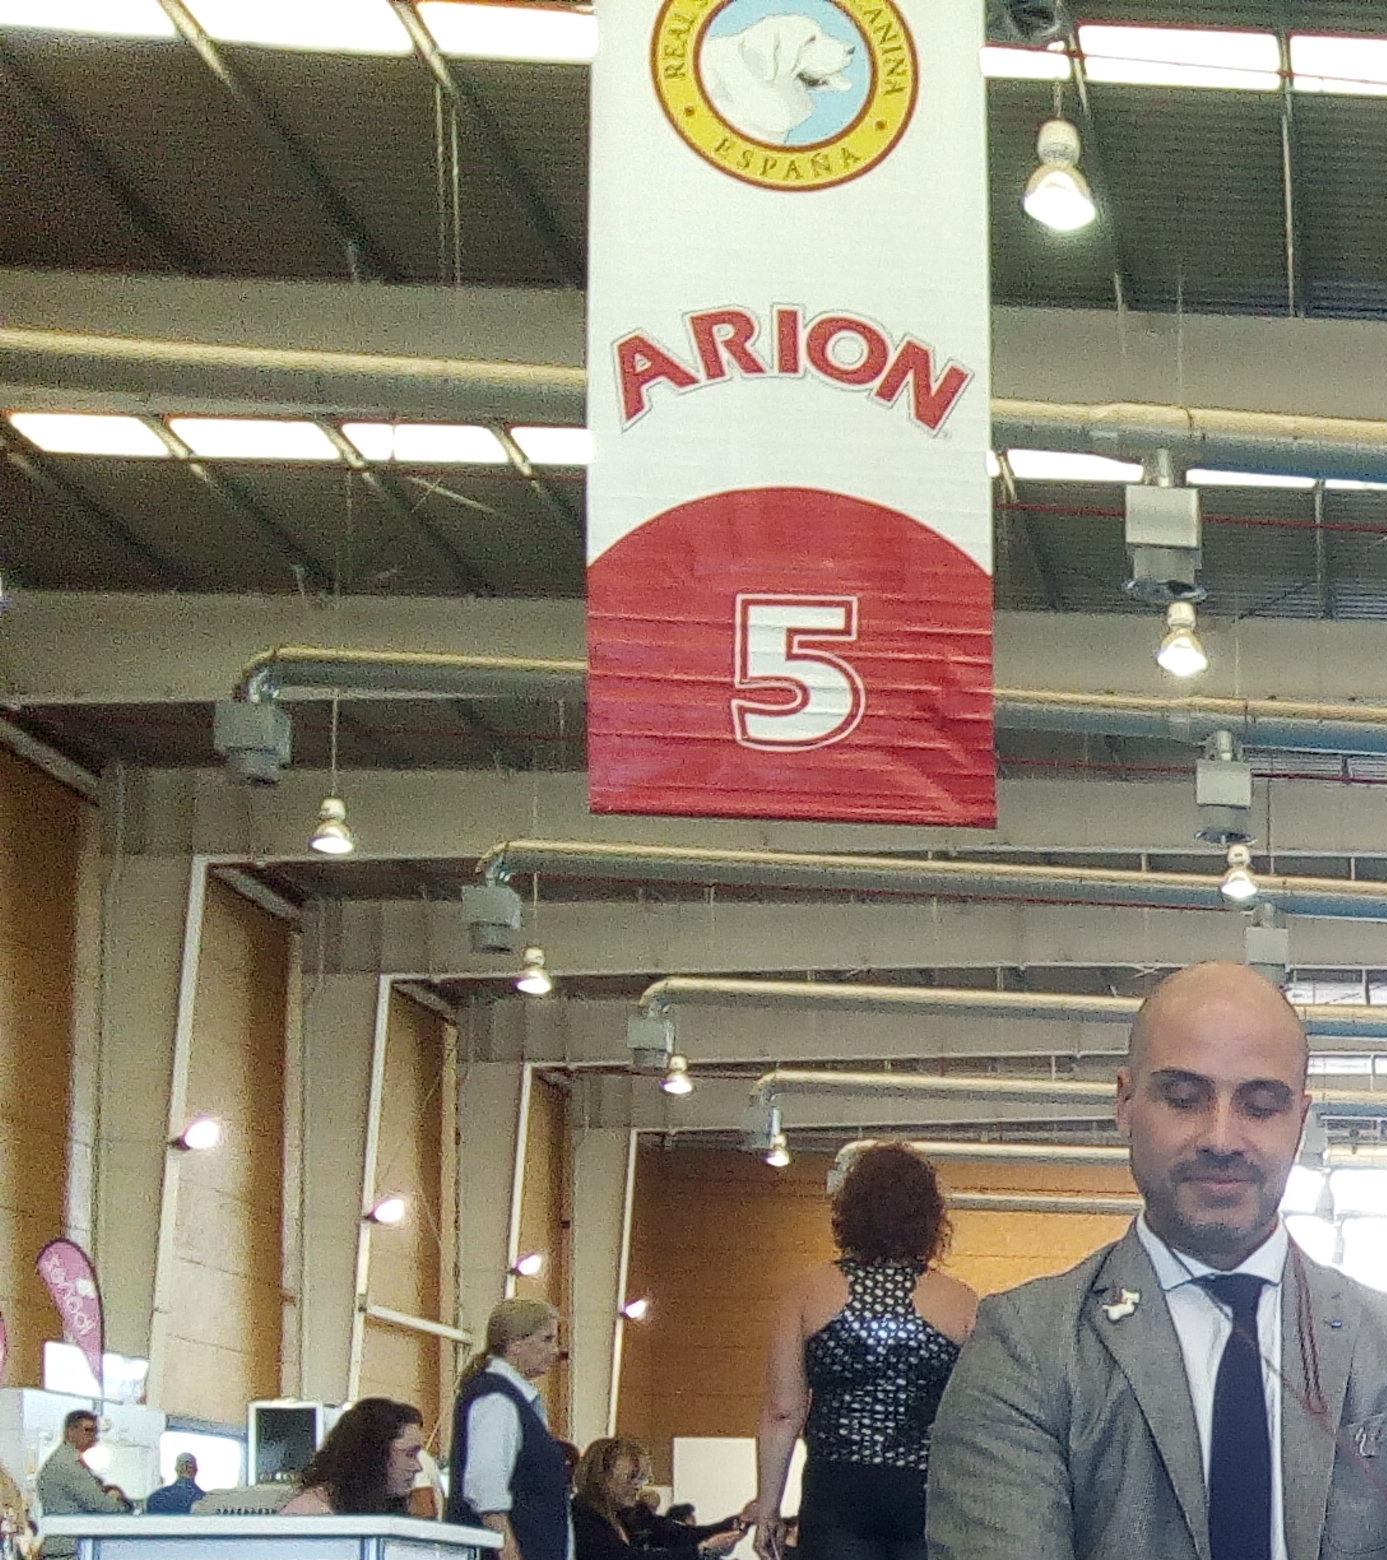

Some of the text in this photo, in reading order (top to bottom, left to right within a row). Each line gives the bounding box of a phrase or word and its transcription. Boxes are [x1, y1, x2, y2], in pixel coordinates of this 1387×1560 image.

[714, 137, 861, 181] ESPAÑA
[614, 305, 972, 434] ARION
[731, 593, 867, 752] 5
